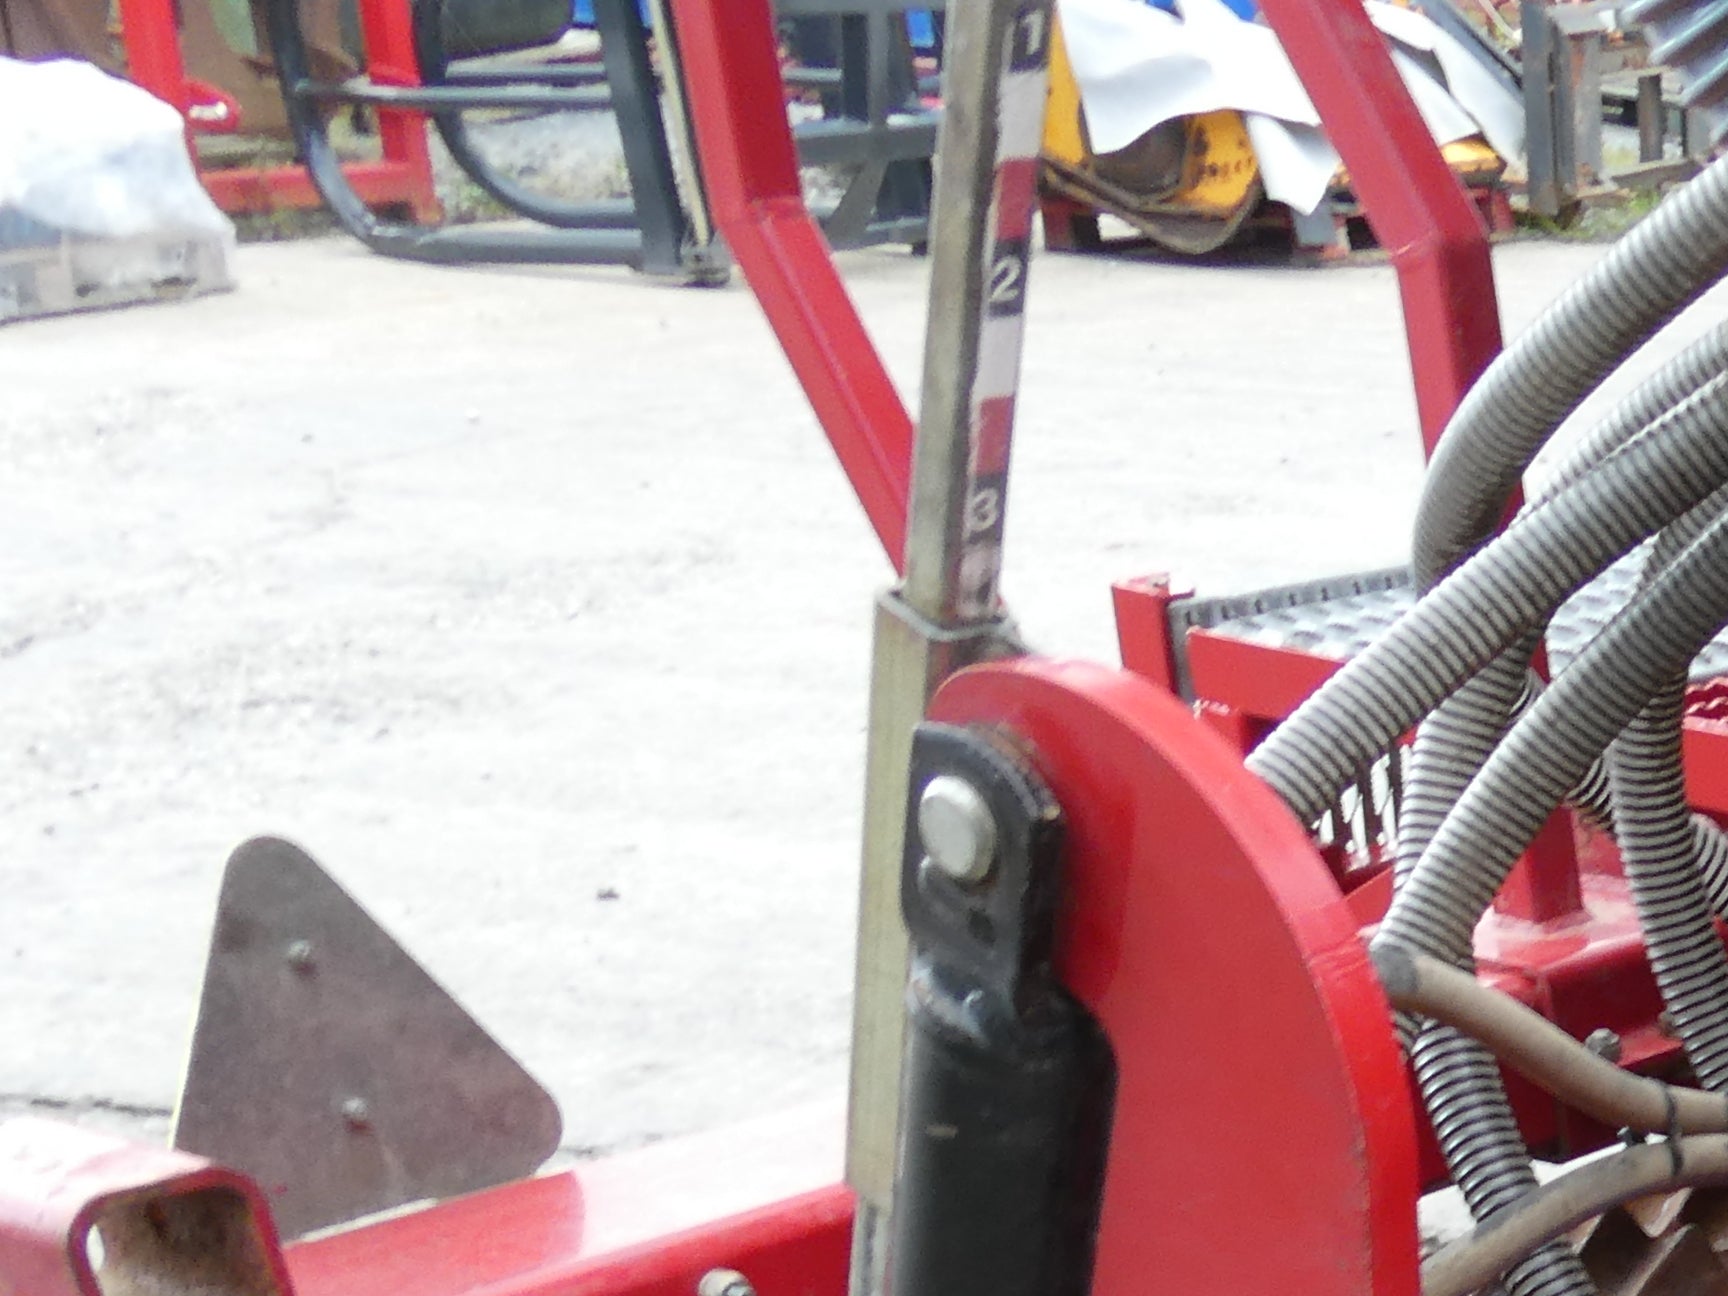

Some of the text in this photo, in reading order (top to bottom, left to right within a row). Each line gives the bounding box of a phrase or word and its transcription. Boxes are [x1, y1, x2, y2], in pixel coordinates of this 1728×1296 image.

[1024, 11, 1043, 54] 1
[990, 258, 1020, 304] 2
[969, 487, 999, 532] 3
